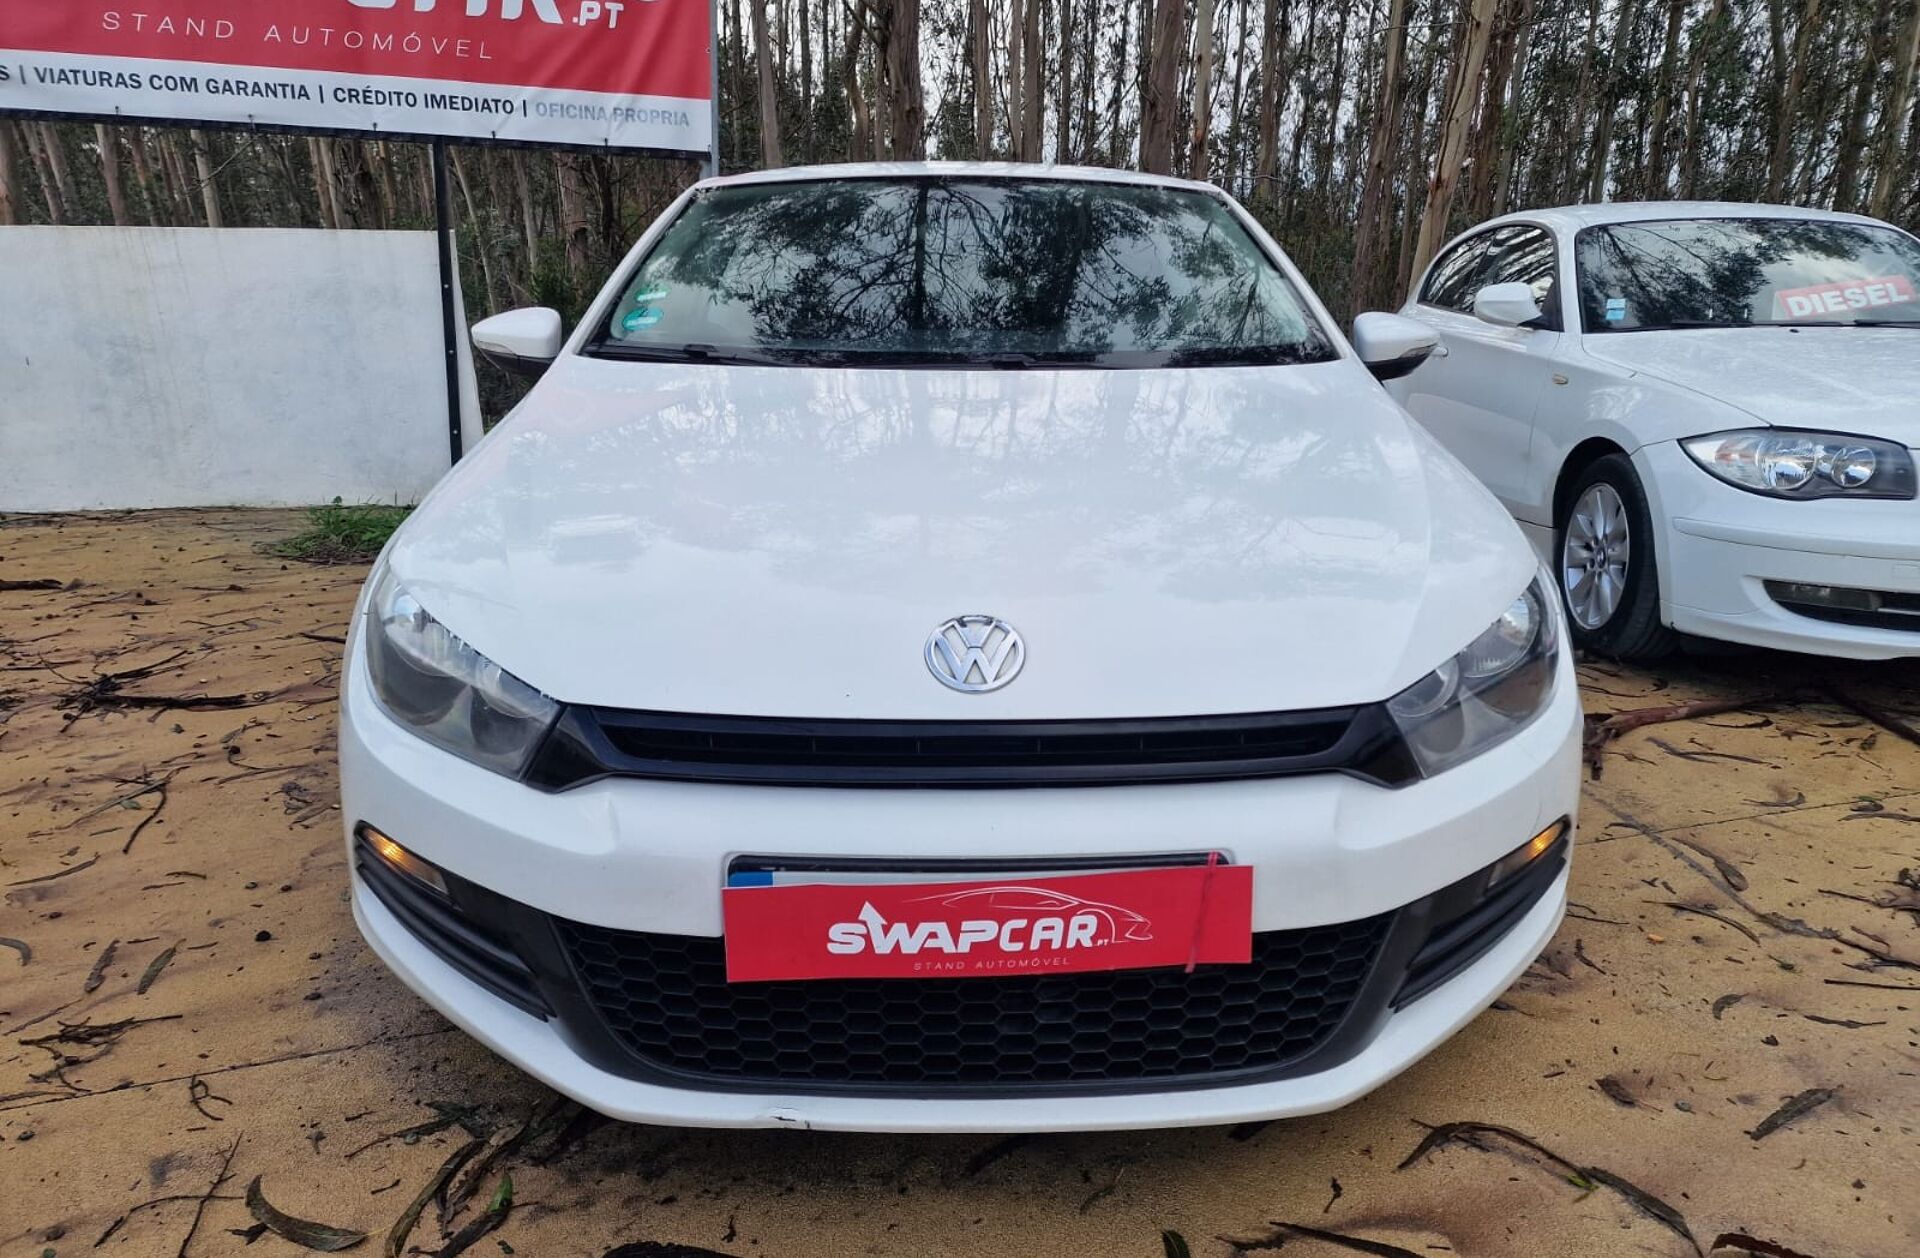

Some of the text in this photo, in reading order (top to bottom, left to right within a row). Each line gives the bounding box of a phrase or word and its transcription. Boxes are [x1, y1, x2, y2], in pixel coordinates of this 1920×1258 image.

[102, 11, 493, 60] STAND AUTOMÓVEL
[34, 66, 143, 90] VIATURAS
[149, 74, 199, 94] COM
[205, 78, 310, 101] GARANTIA
[332, 85, 418, 108] CRÉDITO
[423, 93, 515, 114] IMEDIATO
[535, 102, 607, 121] OFICINA
[612, 107, 690, 127] PROPRIA
[1786, 282, 1910, 317] DIESEL
[826, 900, 1098, 955] SWAPCAR
[913, 956, 1071, 972] STAND AUTOMÓVEL
